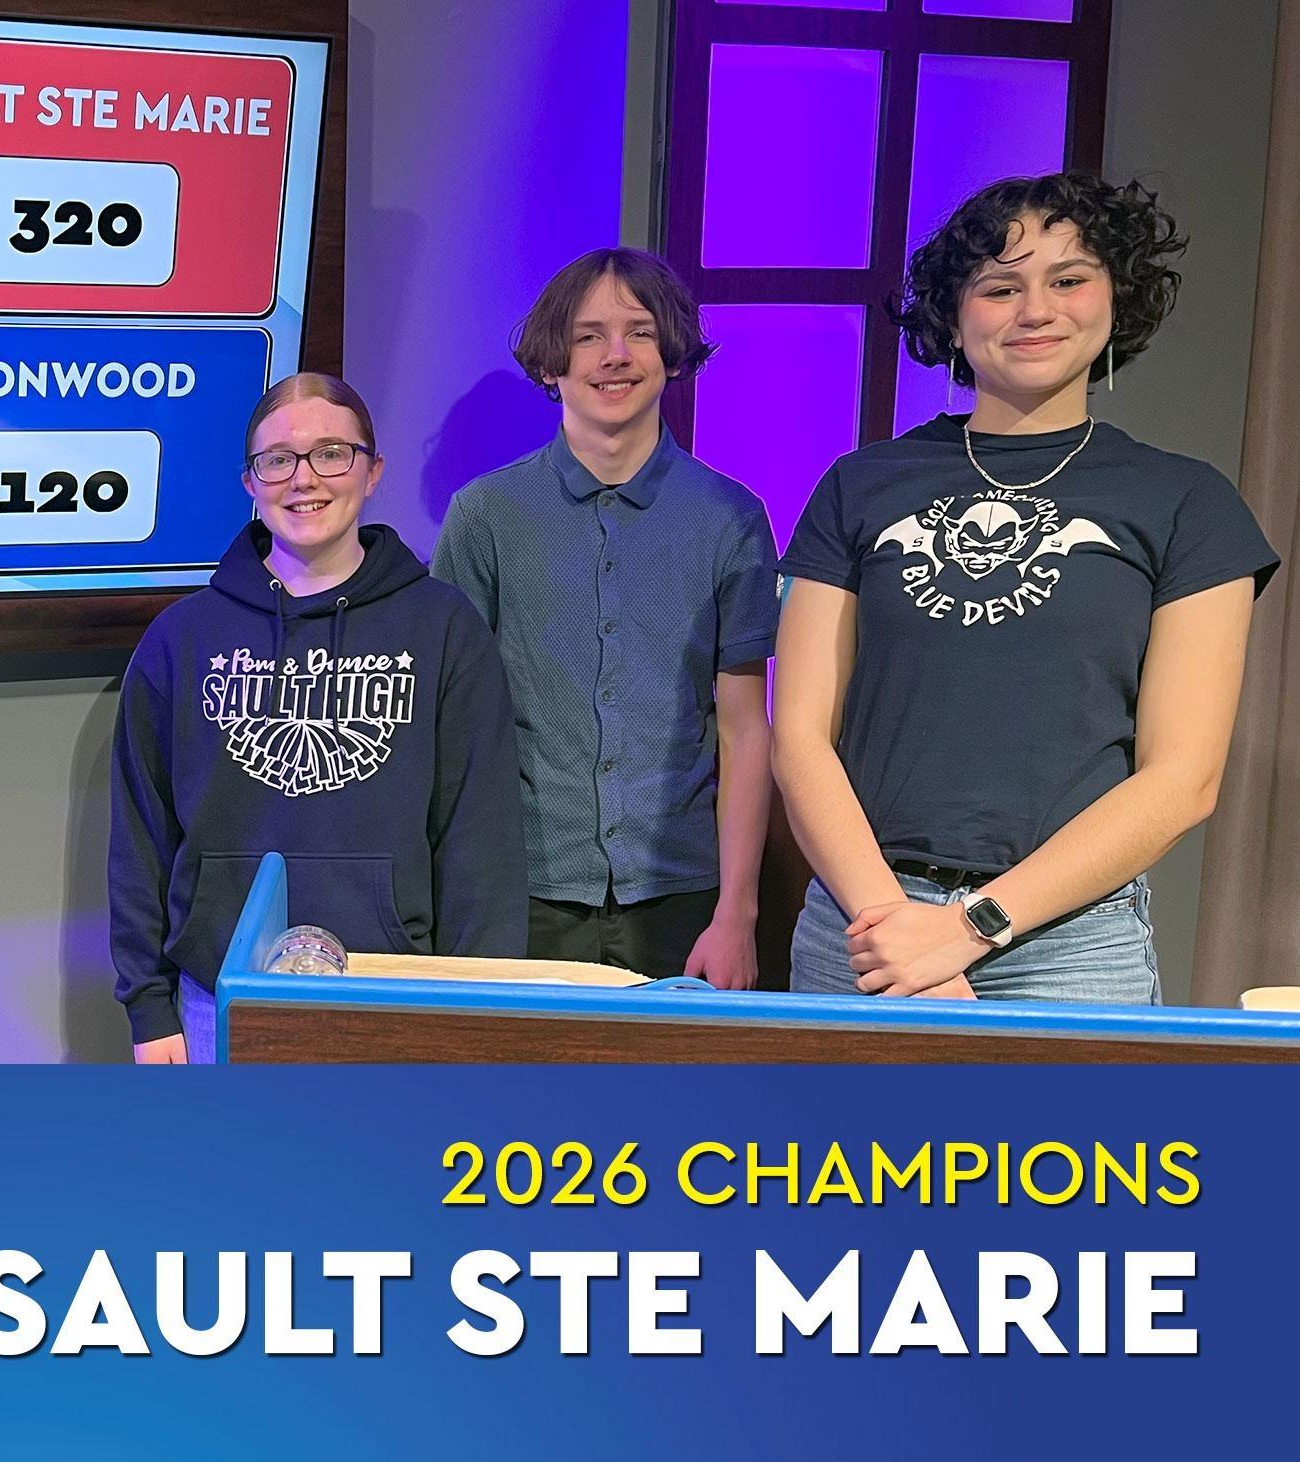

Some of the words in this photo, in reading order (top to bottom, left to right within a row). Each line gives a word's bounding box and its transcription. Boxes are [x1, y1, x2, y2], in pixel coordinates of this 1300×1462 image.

[37, 86, 119, 128] STE
[135, 91, 272, 136] MARIE
[9, 199, 142, 253] 320
[0, 470, 129, 514] 120
[922, 496, 956, 527] 202
[902, 564, 956, 619] BLUE
[961, 565, 1061, 627] DEVILS
[231, 648, 276, 675] Pom
[282, 657, 299, 676] &
[202, 673, 317, 721] SAULT
[321, 673, 416, 724] HIGH
